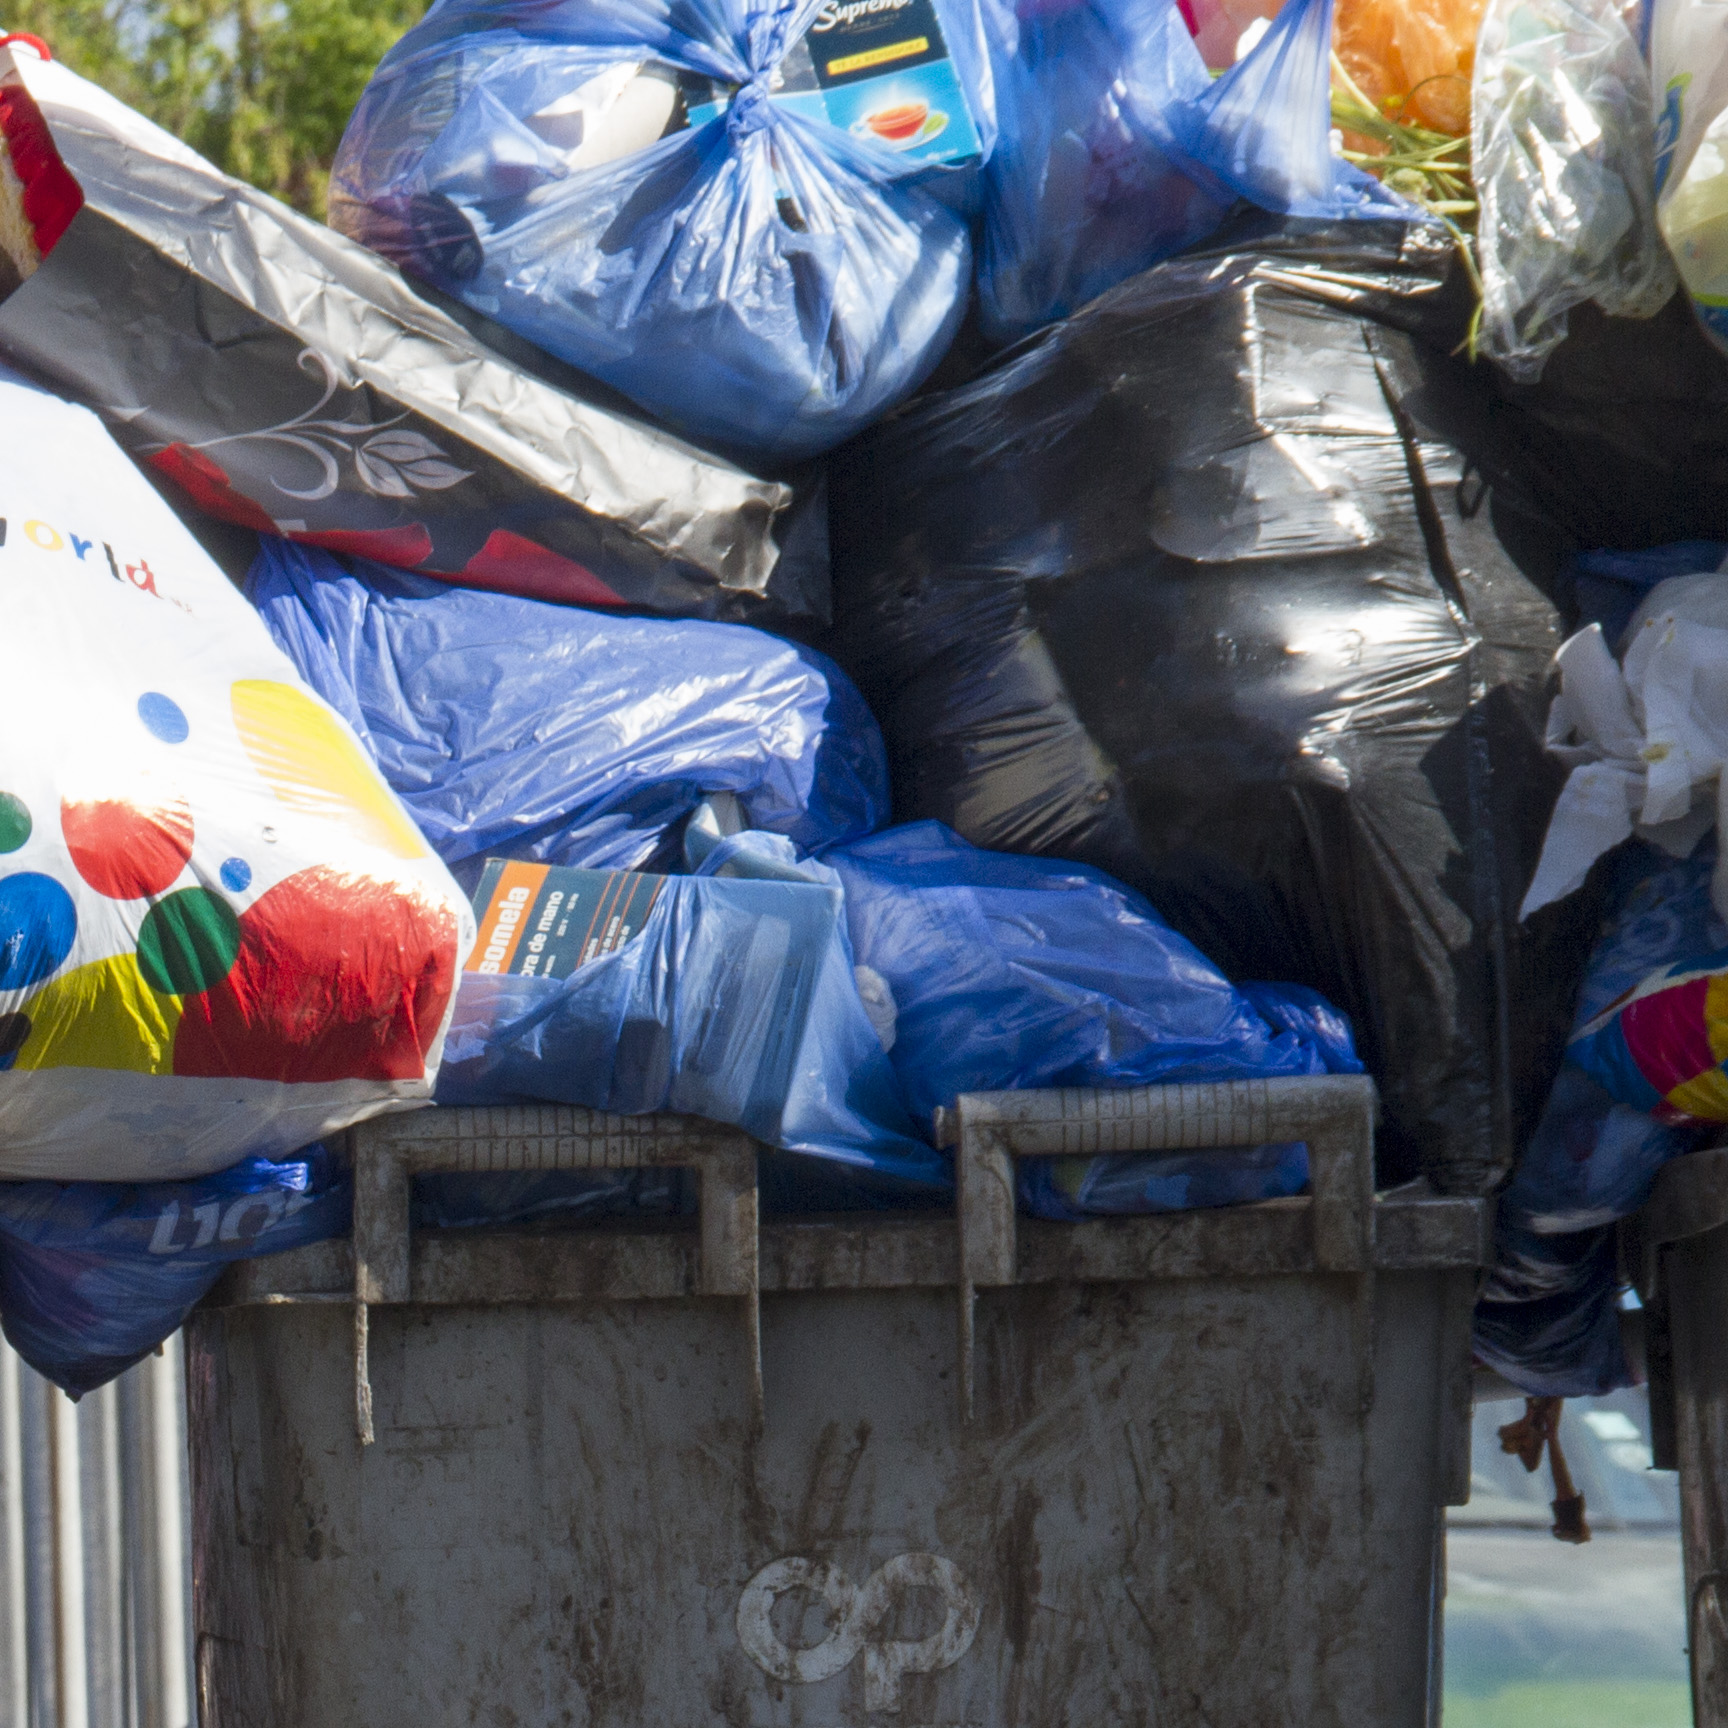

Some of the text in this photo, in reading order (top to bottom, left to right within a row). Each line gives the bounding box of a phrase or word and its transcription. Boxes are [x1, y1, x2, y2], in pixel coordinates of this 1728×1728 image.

[478, 886, 530, 975] somela
[537, 890, 564, 932] mano
[528, 933, 547, 952] de
